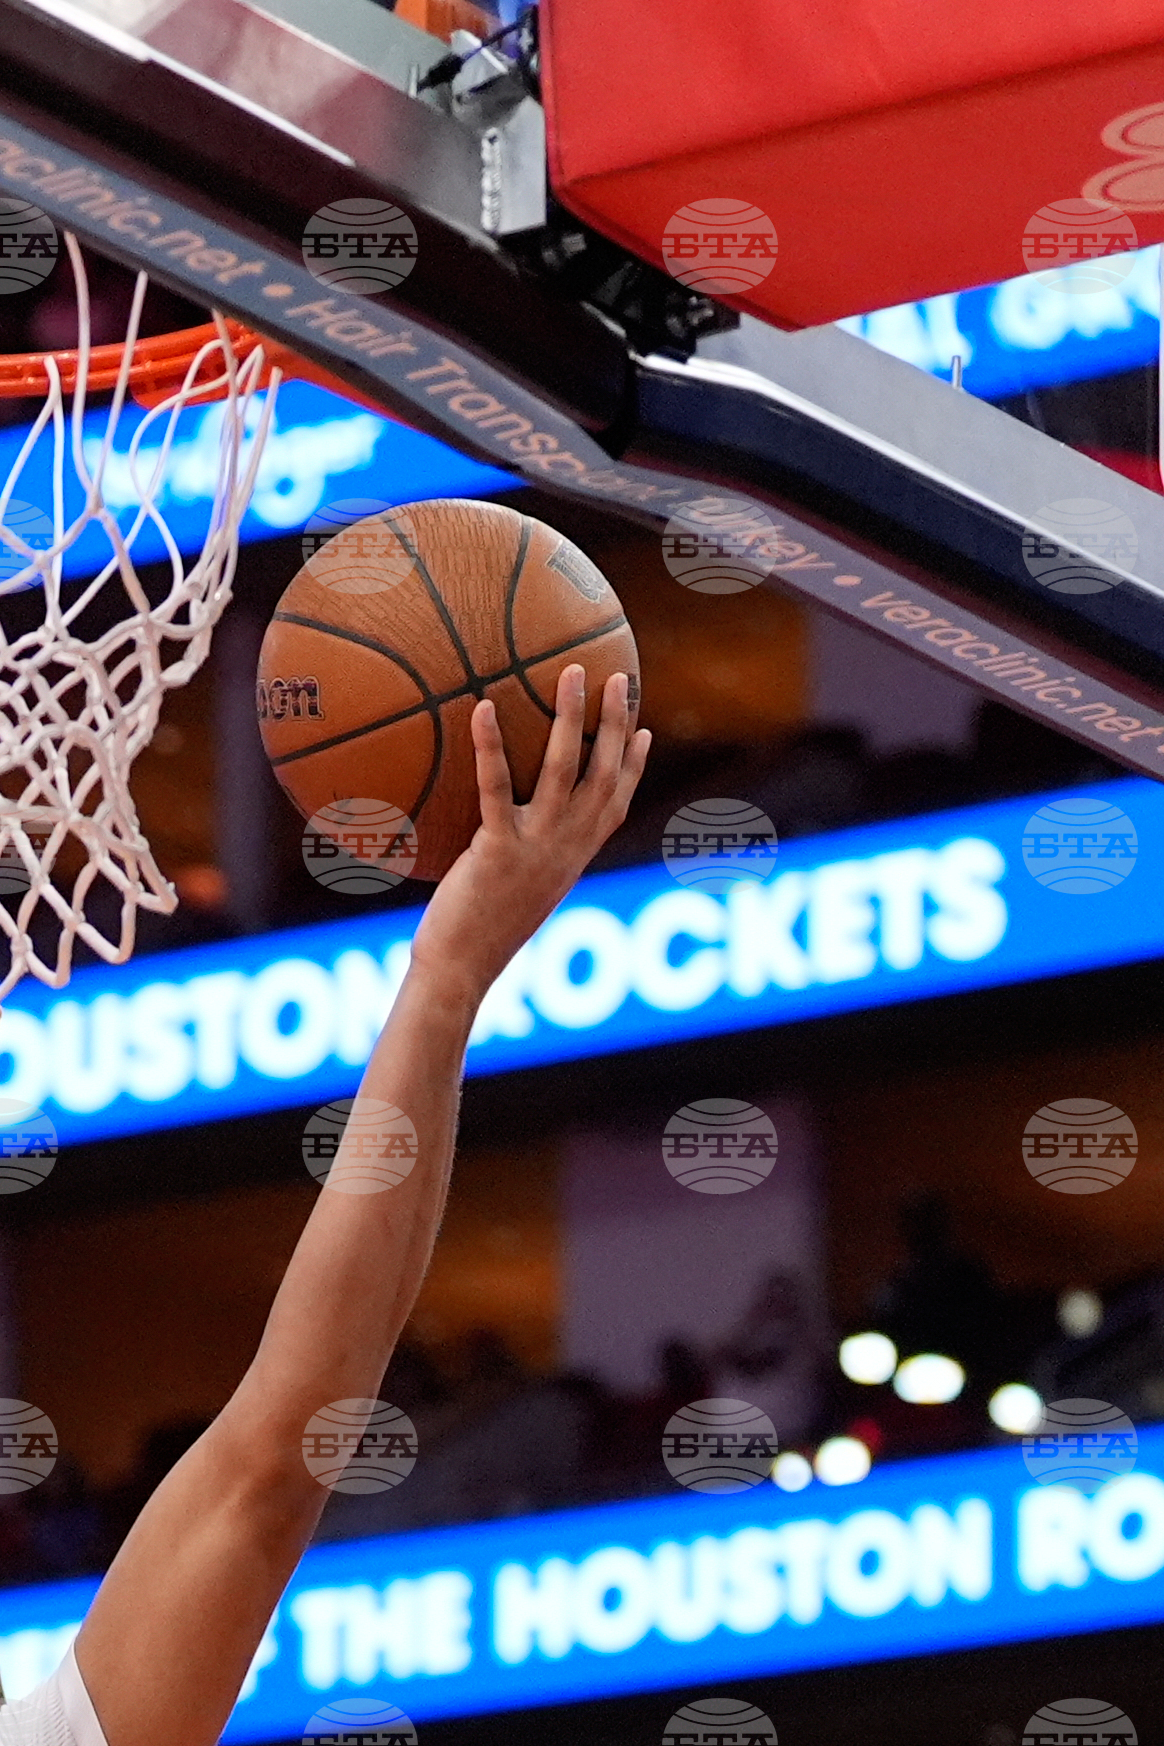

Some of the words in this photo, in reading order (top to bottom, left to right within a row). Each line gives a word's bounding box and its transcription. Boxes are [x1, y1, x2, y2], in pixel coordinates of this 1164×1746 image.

[286, 300, 418, 357] Hair
[861, 591, 1163, 742] veraclinic.net
[291, 1569, 472, 1690] THE
[492, 1497, 994, 1666] HOUSTON
